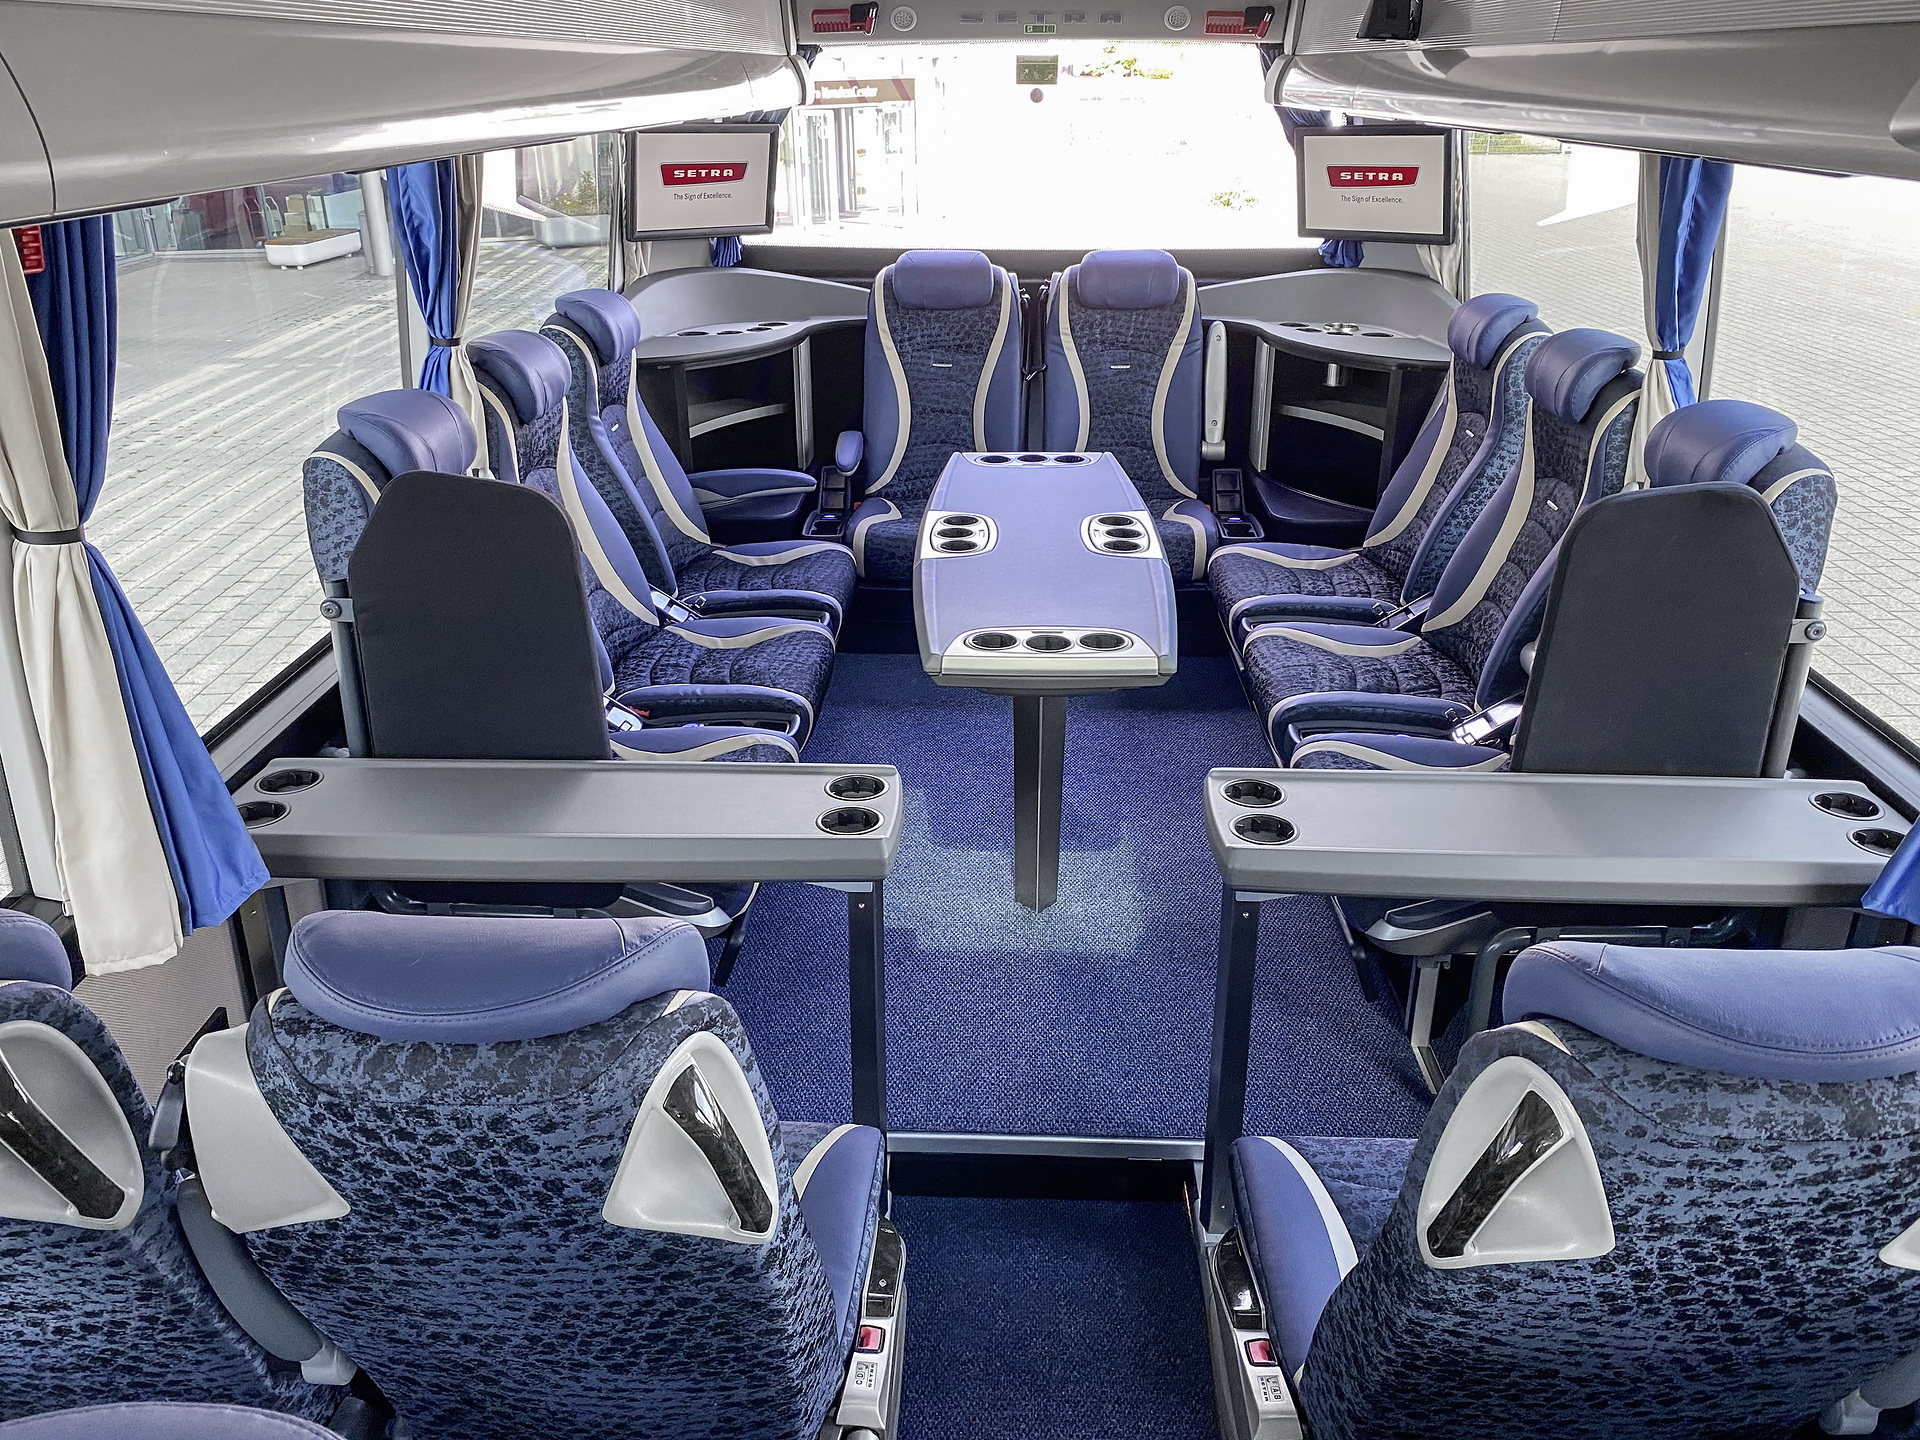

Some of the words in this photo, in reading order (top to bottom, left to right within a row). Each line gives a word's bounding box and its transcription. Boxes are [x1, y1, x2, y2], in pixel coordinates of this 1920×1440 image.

[960, 11, 1123, 24] SETRA
[673, 168, 734, 178] SETRA
[1340, 172, 1404, 181] SETRA
[684, 193, 697, 202] Sign
[703, 192, 733, 200] Excellence.
[1351, 195, 1365, 204] Sign
[1371, 196, 1404, 204] Excellence.
